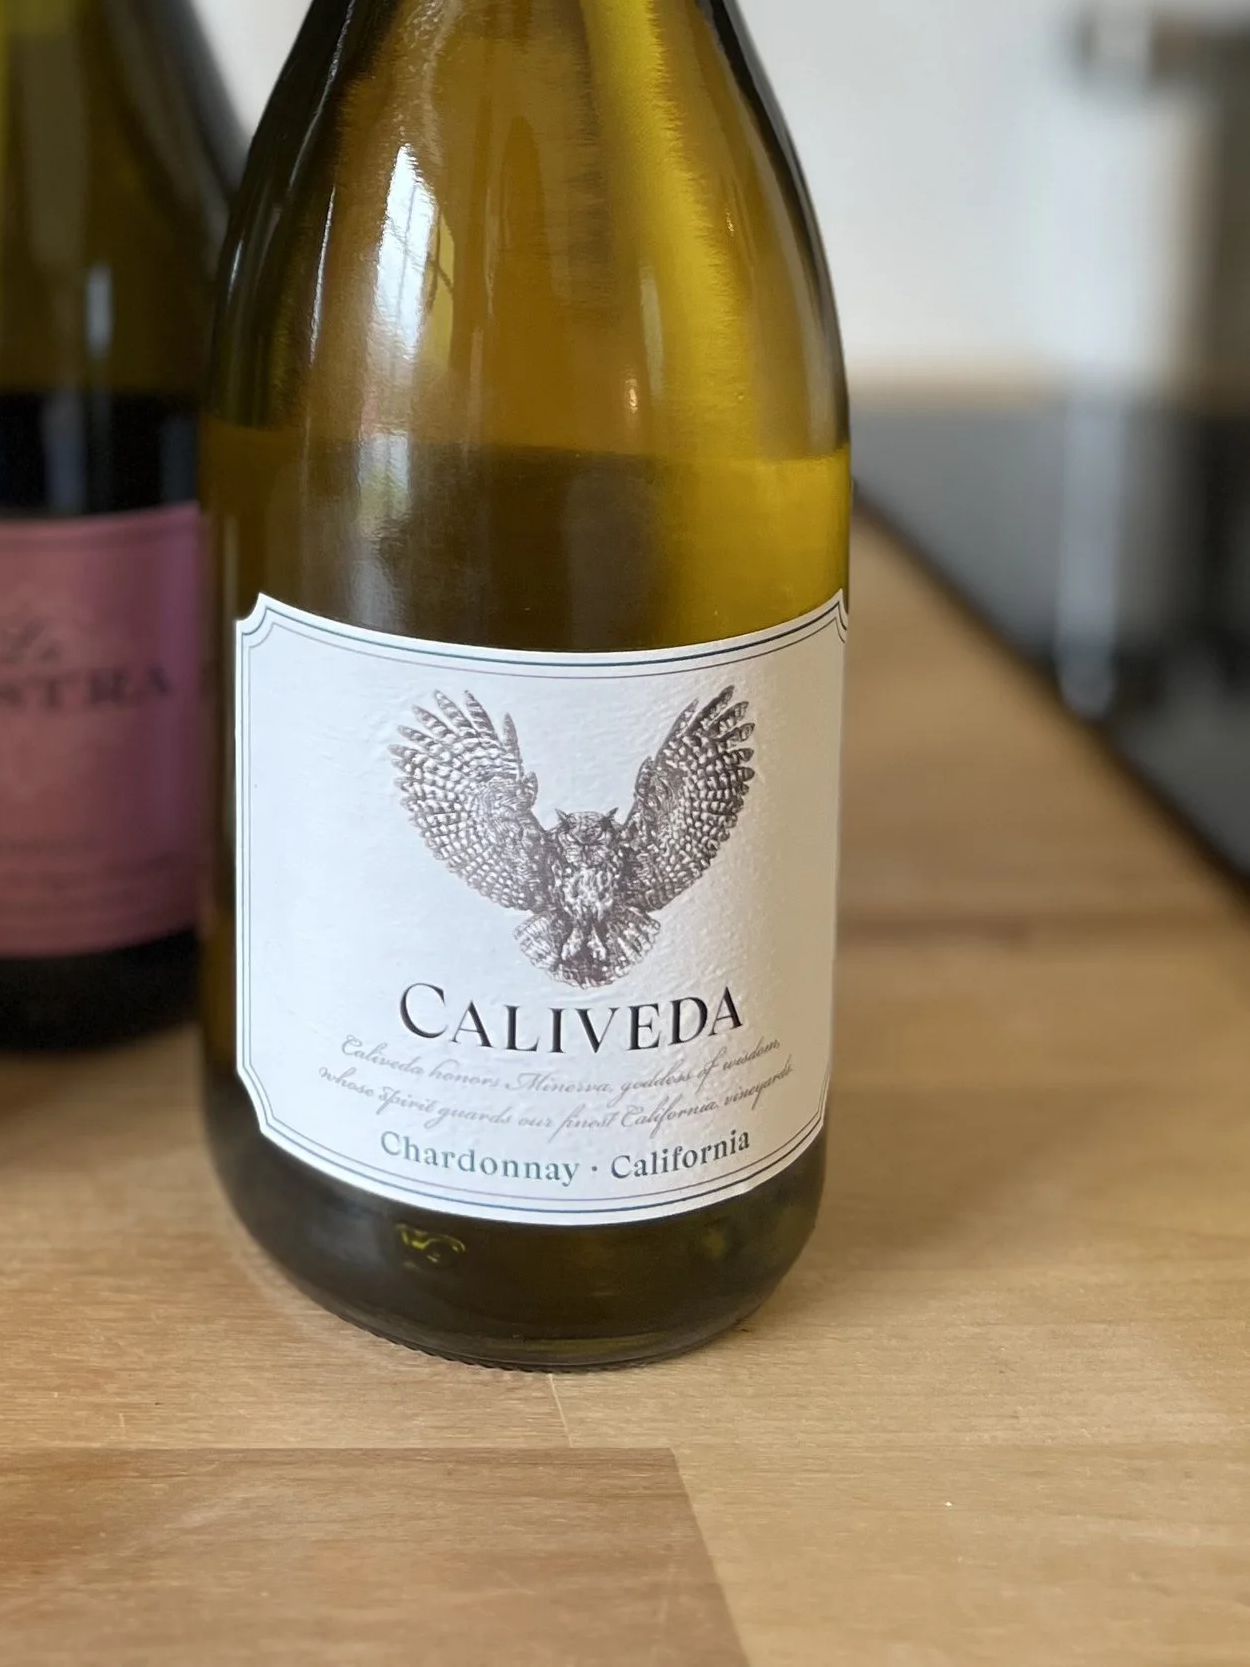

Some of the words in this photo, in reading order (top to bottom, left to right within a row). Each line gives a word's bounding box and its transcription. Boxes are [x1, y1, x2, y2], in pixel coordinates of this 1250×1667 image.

[319, 1065, 375, 1097] whose
[375, 1086, 439, 1116] spirit
[423, 1105, 513, 1130] guards
[518, 1115, 554, 1128] our
[547, 1103, 621, 1145] finest
[341, 1034, 425, 1076] Caliveda
[428, 1058, 501, 1087] honors
[607, 1057, 693, 1109] goddess
[696, 1045, 727, 1095] of
[379, 1130, 580, 1188] Chardonnay
[610, 1129, 751, 1180] California
